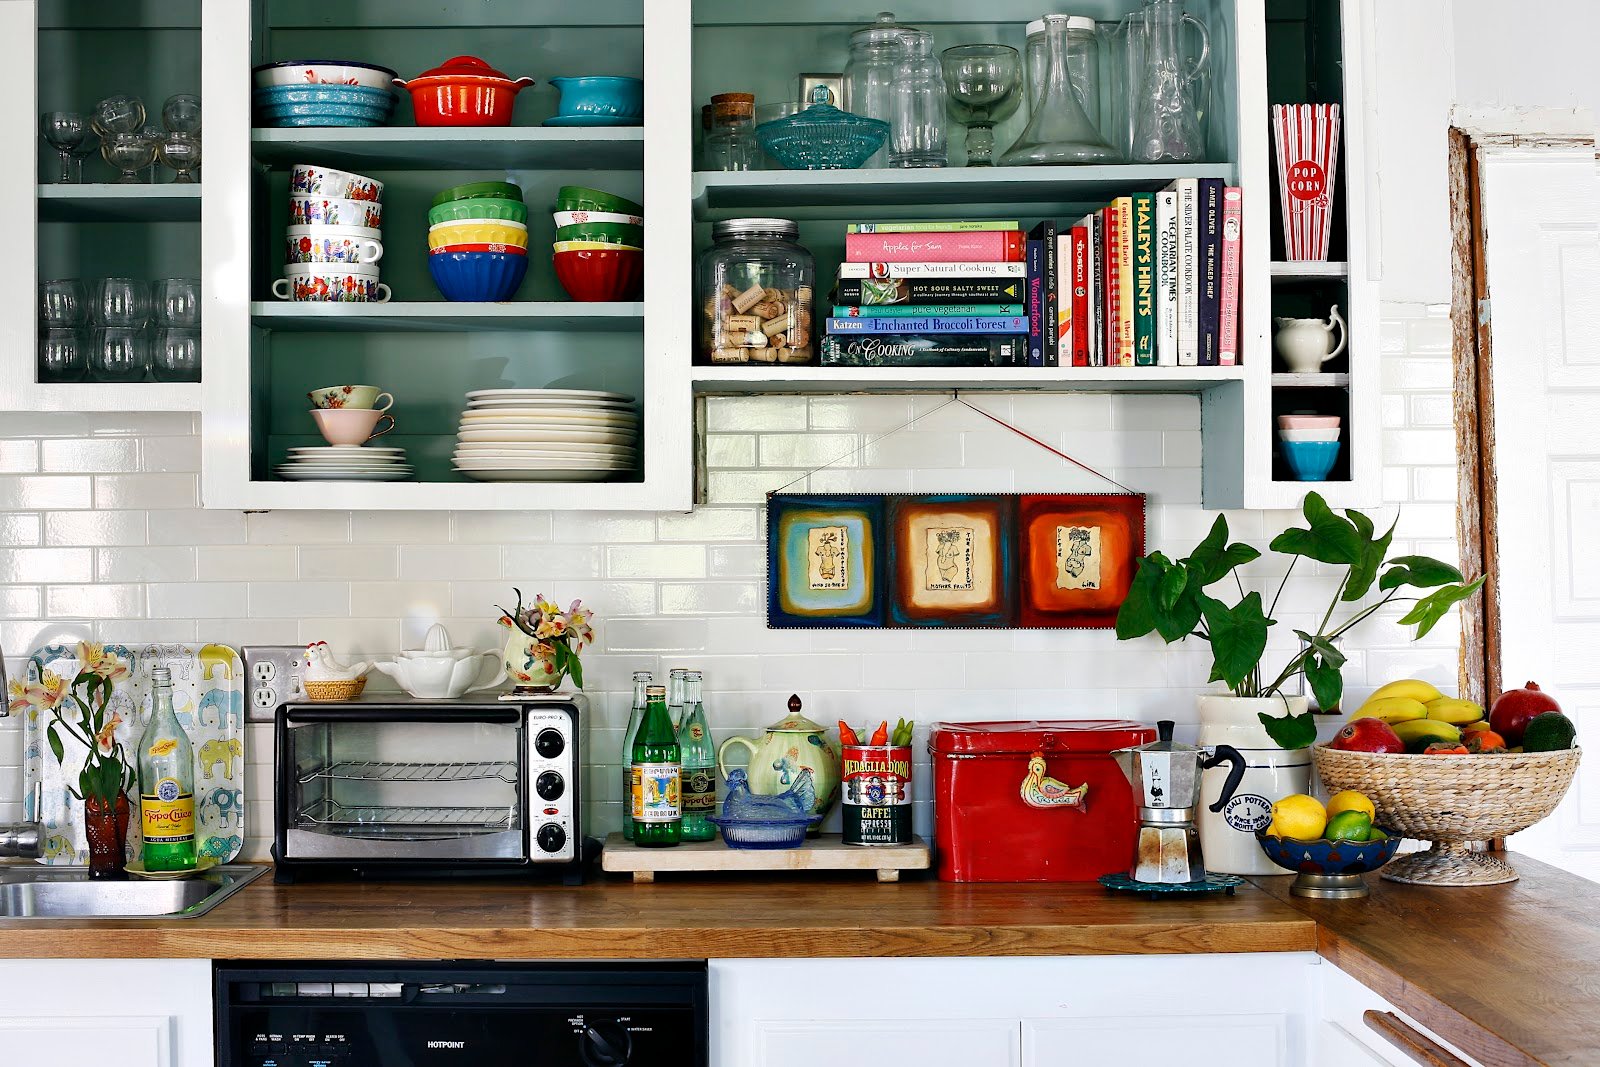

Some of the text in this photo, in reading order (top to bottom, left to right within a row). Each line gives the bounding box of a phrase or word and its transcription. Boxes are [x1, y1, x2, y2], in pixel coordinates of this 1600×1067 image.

[1294, 168, 1316, 178] POP
[1291, 180, 1320, 191] CORN
[883, 240, 942, 254] Apples for Jam
[1138, 199, 1151, 316] HALEY'S HINTS
[894, 264, 997, 274] Super Natural Cooking
[912, 305, 977, 315] pure vegetarian
[1032, 277, 1040, 337] Wonderfoods
[833, 320, 862, 329] Katzen
[874, 318, 928, 330] Enchanted
[933, 318, 973, 330] Broccoli
[976, 319, 1006, 329] Forest
[844, 760, 908, 779] MEDAGLIA D'ORO
[1244, 797, 1272, 813] POTTERY
[145, 808, 192, 823] Topo Chico
[1246, 807, 1251, 816] 1
[1234, 815, 1250, 824] SINCE
[1234, 822, 1254, 830] MONTE
